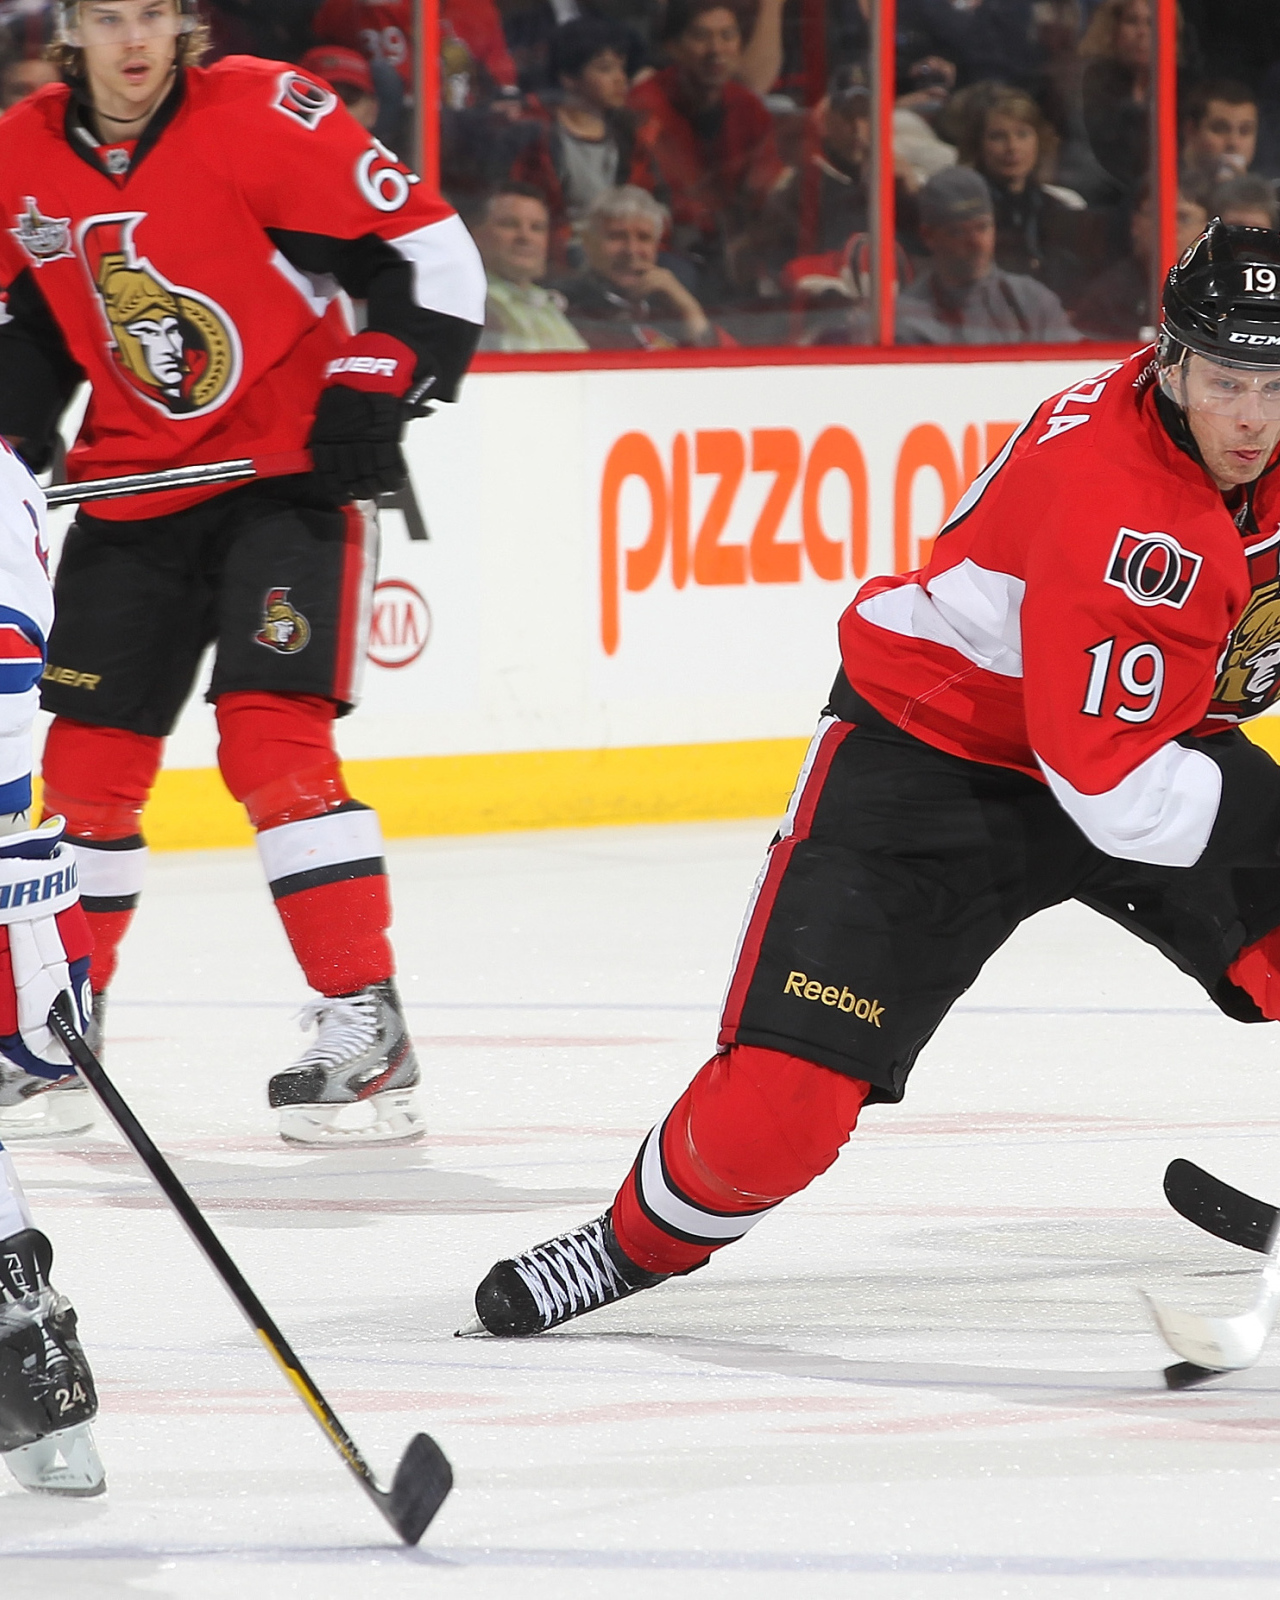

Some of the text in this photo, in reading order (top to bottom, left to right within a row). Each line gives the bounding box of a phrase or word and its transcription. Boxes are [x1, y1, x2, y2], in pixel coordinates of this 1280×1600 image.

[1241, 266, 1278, 293] 19
[323, 355, 399, 378] UER
[42, 663, 101, 690] UER
[1079, 636, 1165, 723] 19
[783, 970, 886, 1028] Reebok
[54, 1382, 88, 1416] 24
